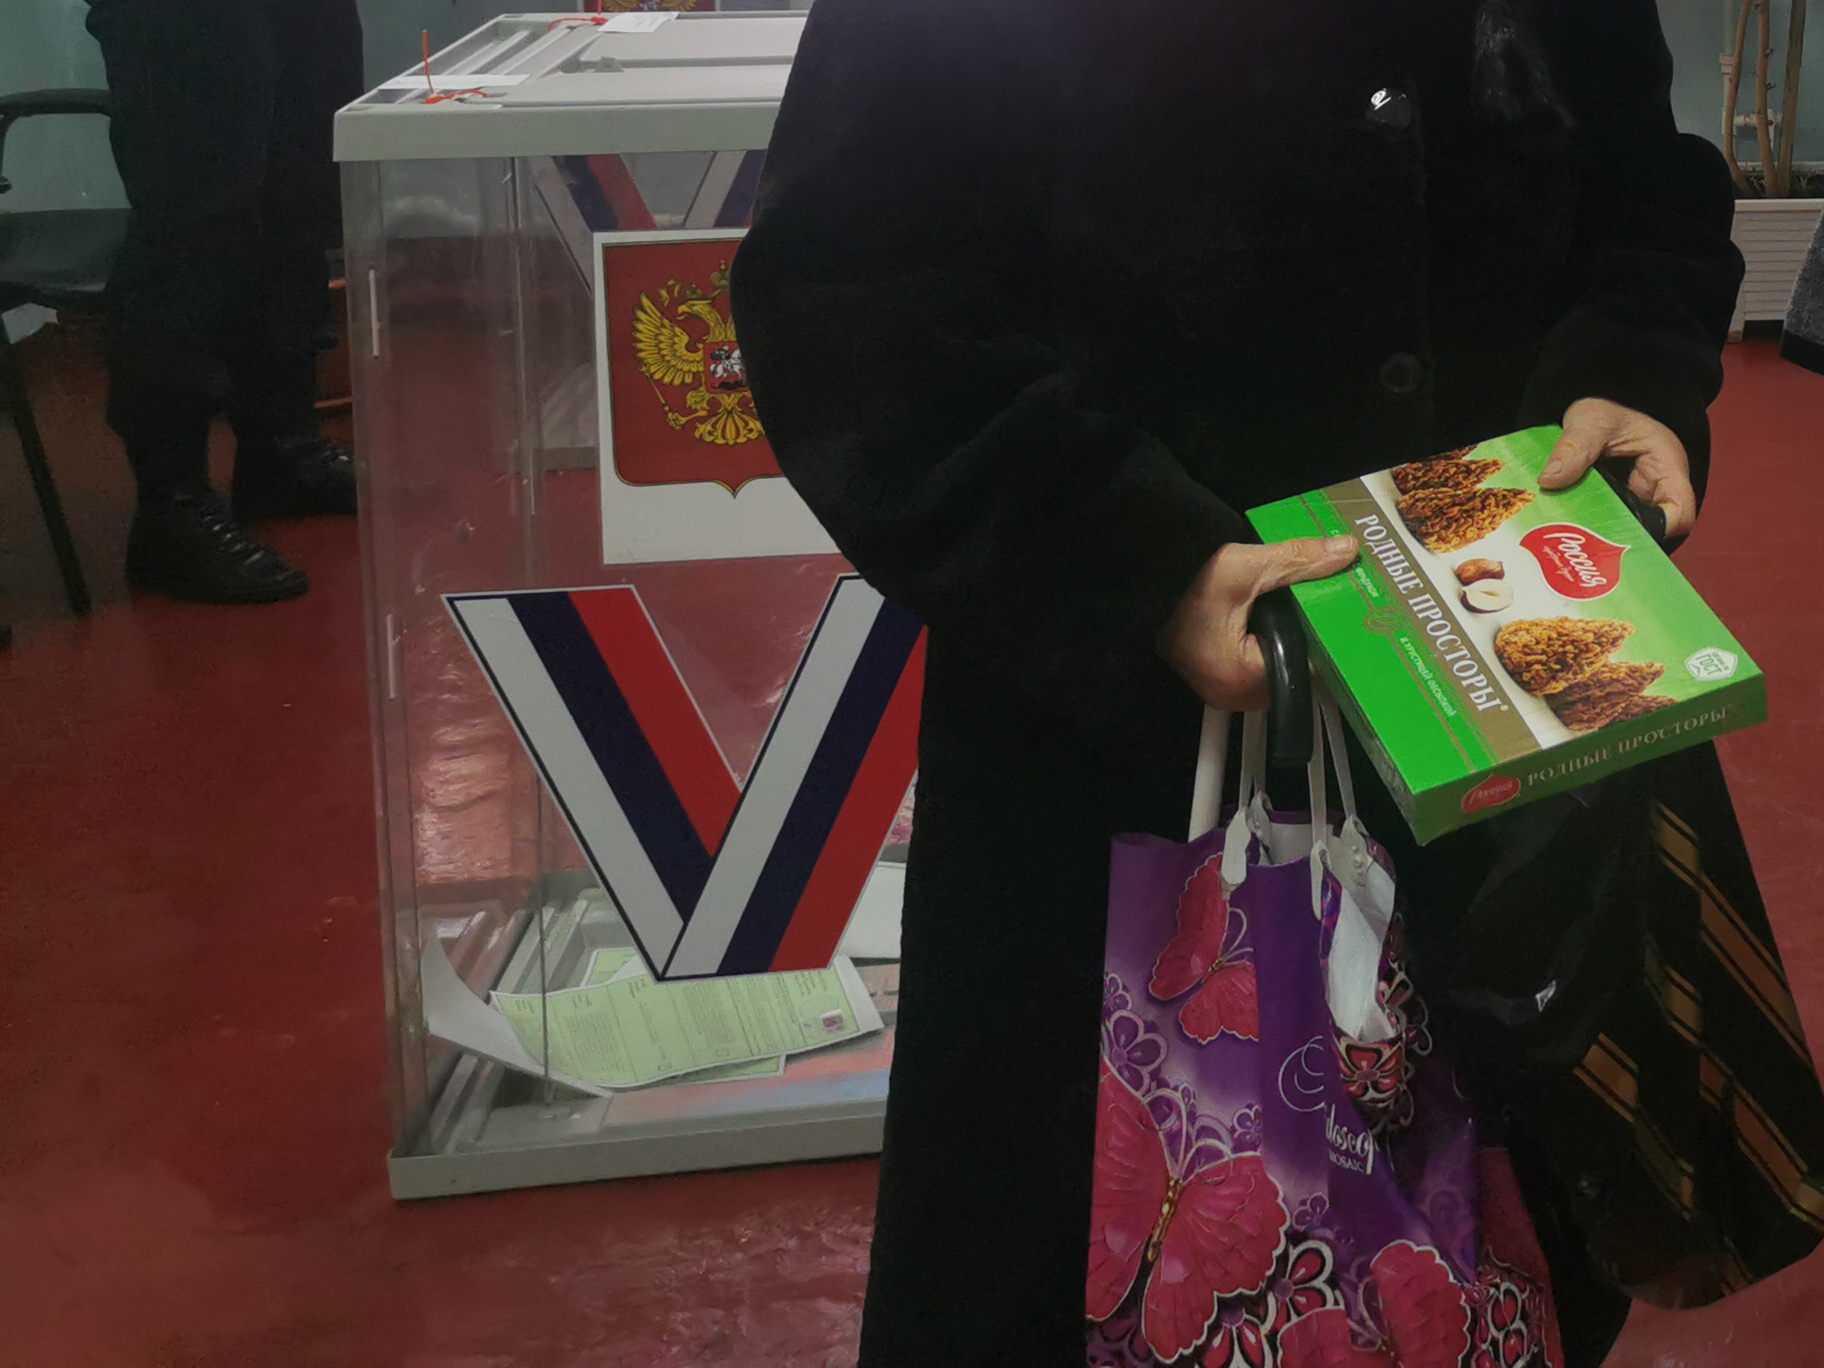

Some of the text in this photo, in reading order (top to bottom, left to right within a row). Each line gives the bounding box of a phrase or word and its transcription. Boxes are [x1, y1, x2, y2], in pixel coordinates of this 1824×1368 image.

[1542, 531, 1608, 588] Россия
[1355, 514, 1504, 713] РОДНЫЕ ПРОСТОРЫ
[1527, 707, 1727, 786] РОДНЫЕ ПРОСТОРЫ
